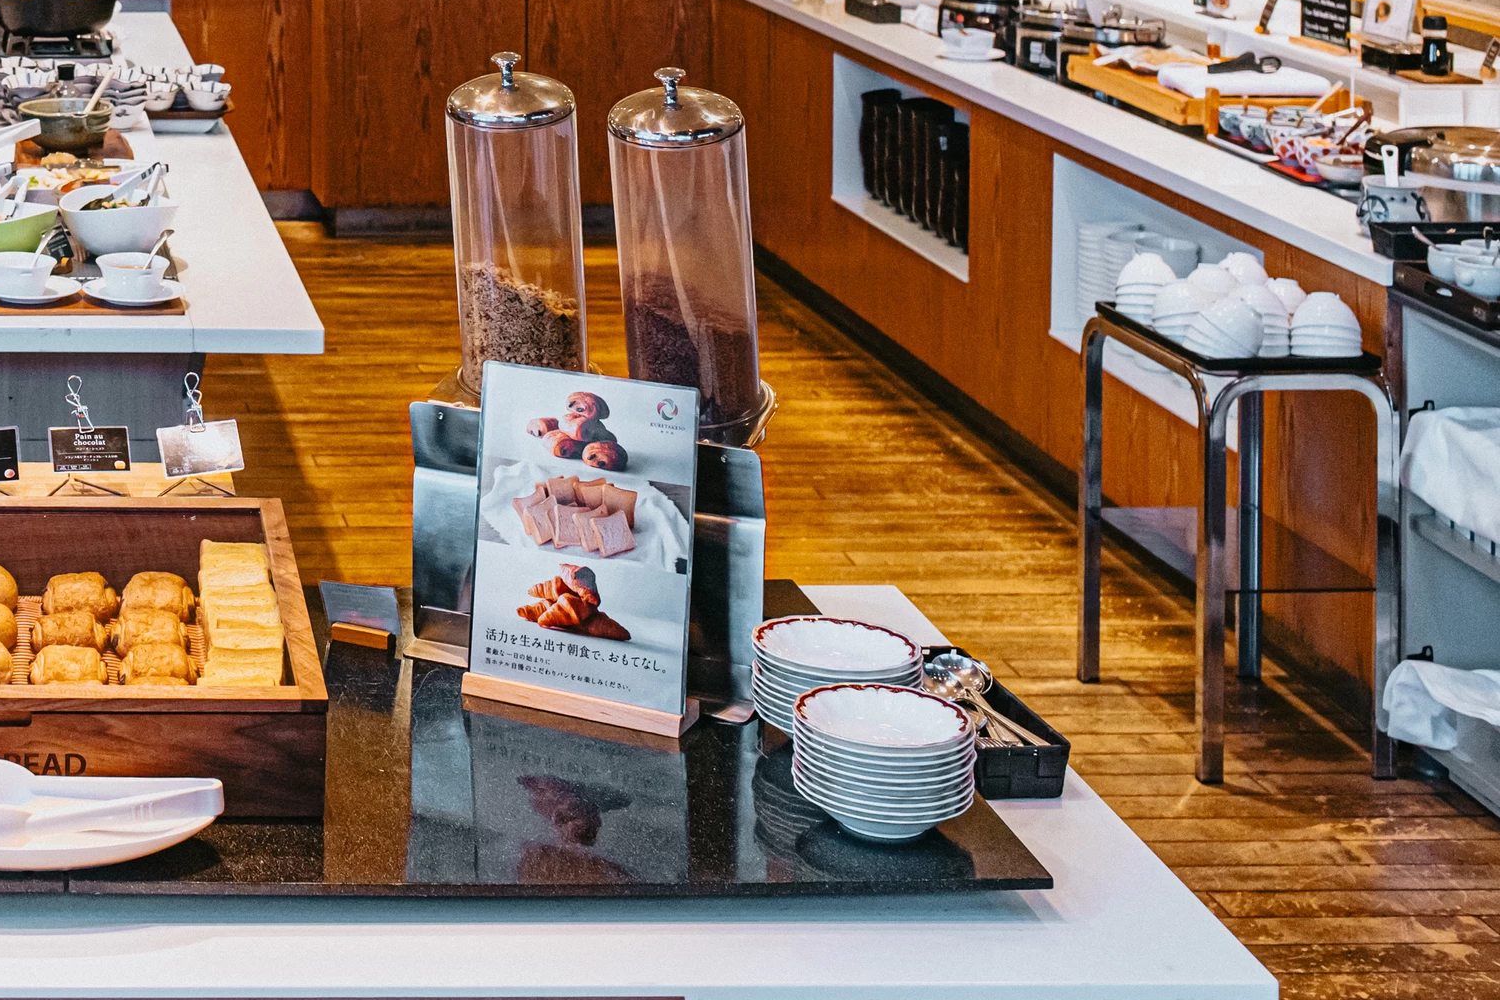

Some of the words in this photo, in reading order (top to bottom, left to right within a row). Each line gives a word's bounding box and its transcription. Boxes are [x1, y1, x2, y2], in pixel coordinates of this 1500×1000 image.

[485, 627, 668, 675] 活力を生み出す朝食で、おもてなし。
[485, 646, 551, 665] 素敵な一日の始まりに
